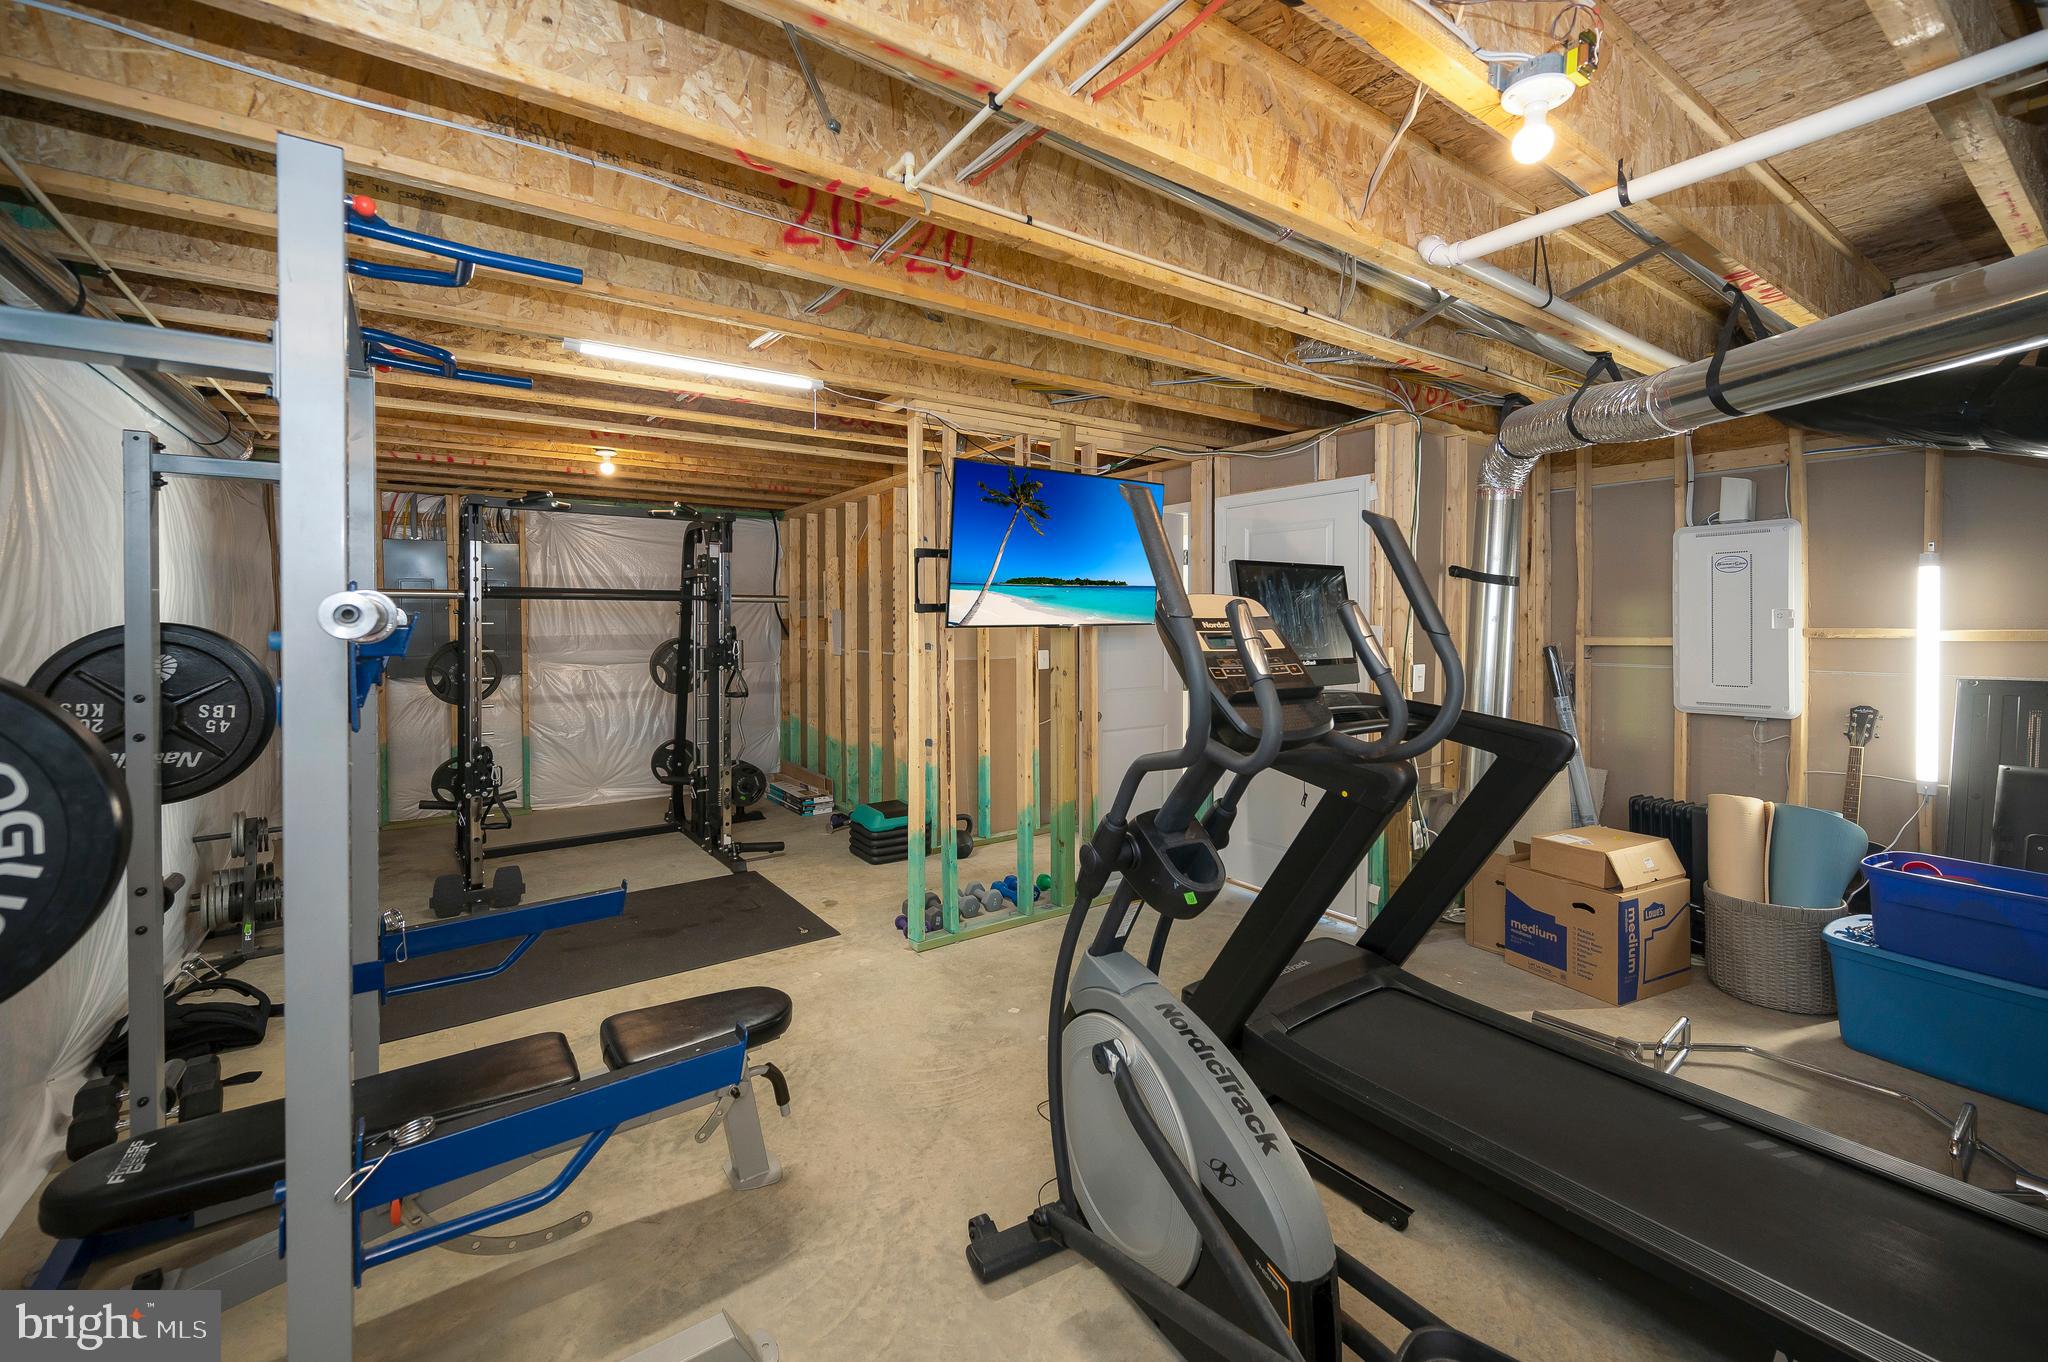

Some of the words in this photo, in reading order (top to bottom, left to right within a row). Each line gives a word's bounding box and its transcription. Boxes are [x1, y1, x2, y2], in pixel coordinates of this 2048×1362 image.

[198, 704, 236, 719] LBS
[205, 719, 231, 733] 45
[1510, 918, 1558, 943] medium
[1628, 906, 1639, 974] medium
[1154, 1002, 1281, 1158] NordicTrack
[106, 1140, 145, 1185] FITNESS
